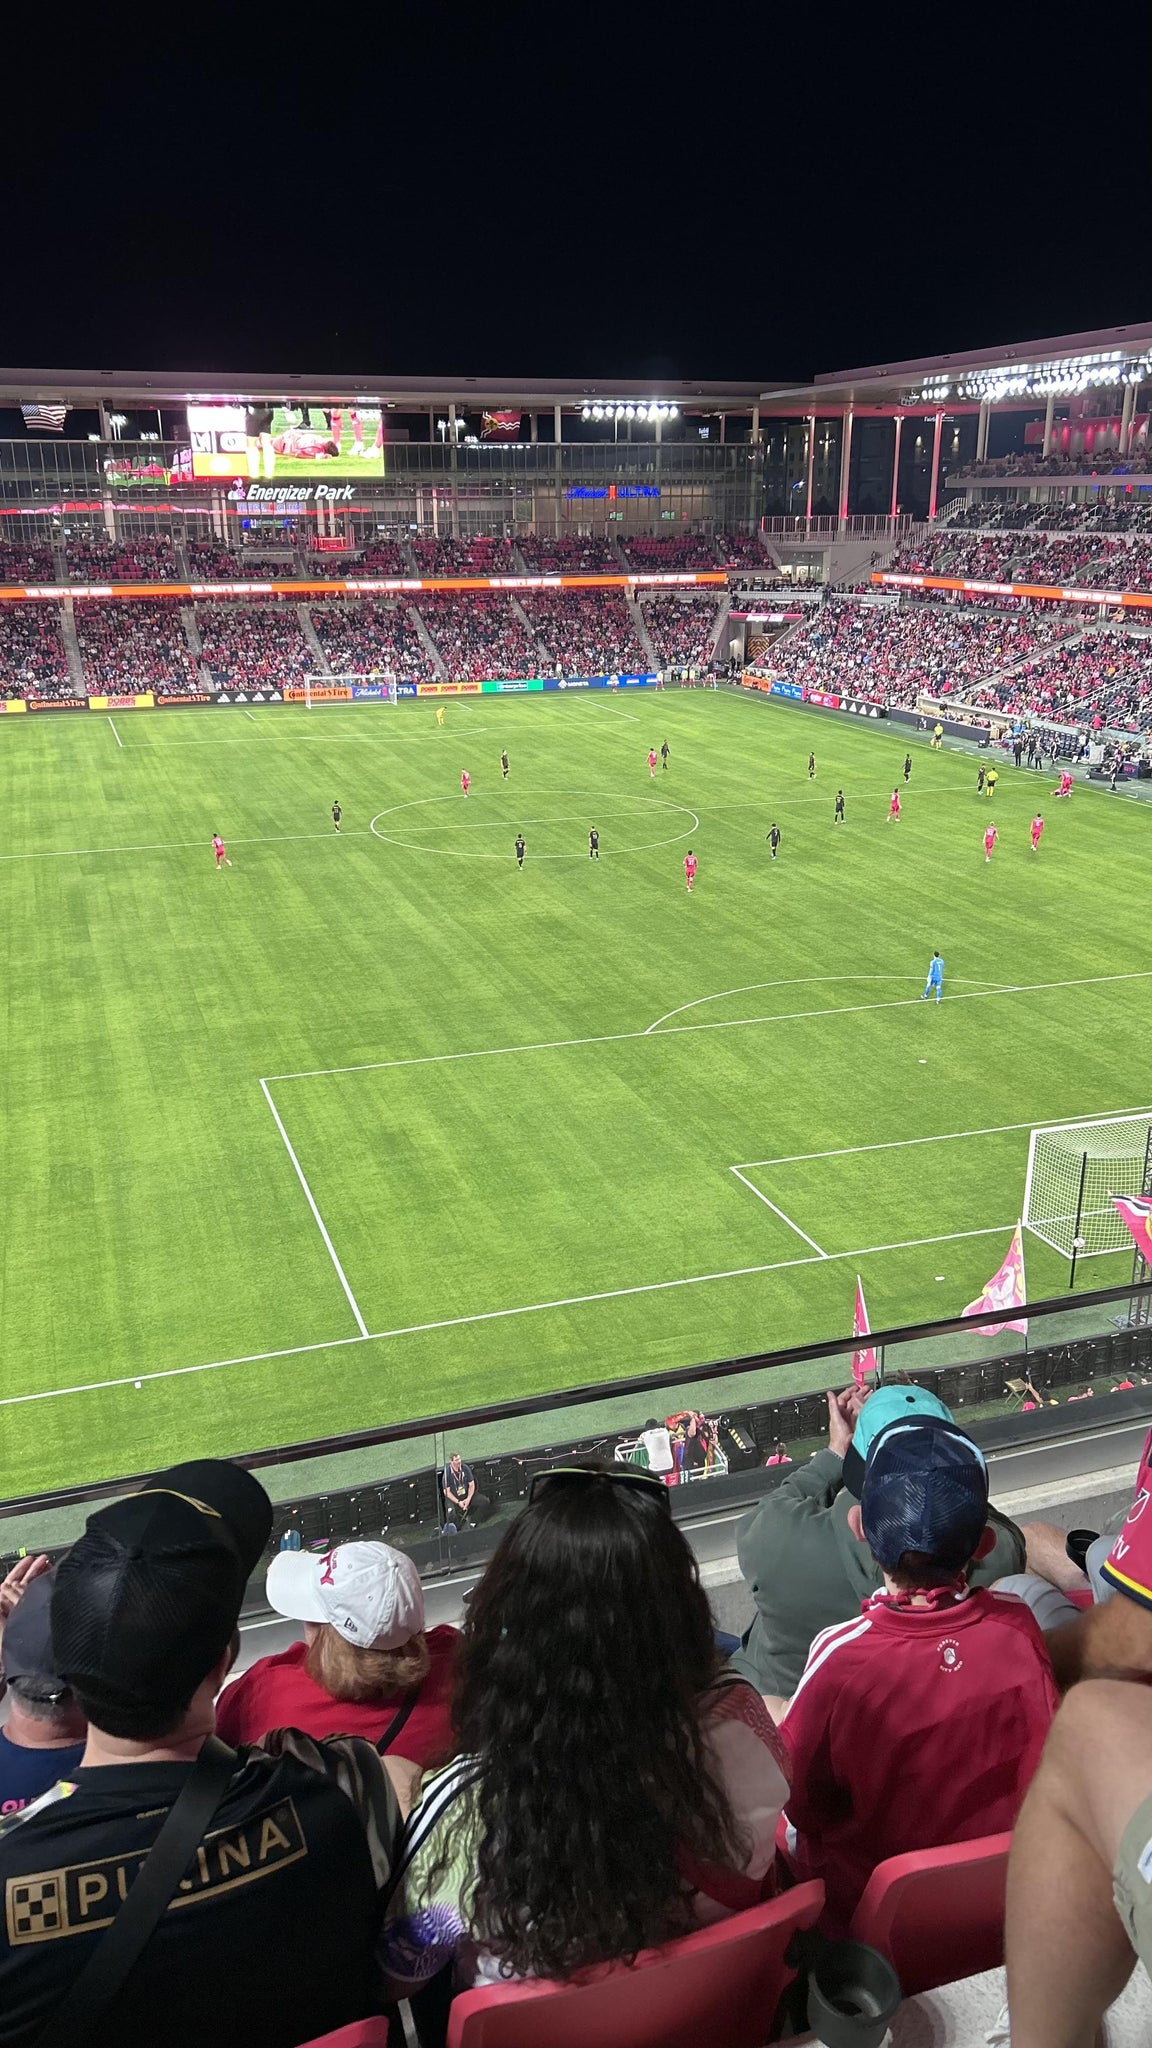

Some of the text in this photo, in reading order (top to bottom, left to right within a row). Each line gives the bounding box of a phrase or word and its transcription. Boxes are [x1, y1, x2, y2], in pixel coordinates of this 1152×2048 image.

[247, 484, 357, 503] Energizer Park
[618, 485, 660, 498] ULTRA
[388, 686, 415, 695] ULTRA
[195, 694, 211, 702] Tire
[70, 699, 86, 707] Tire
